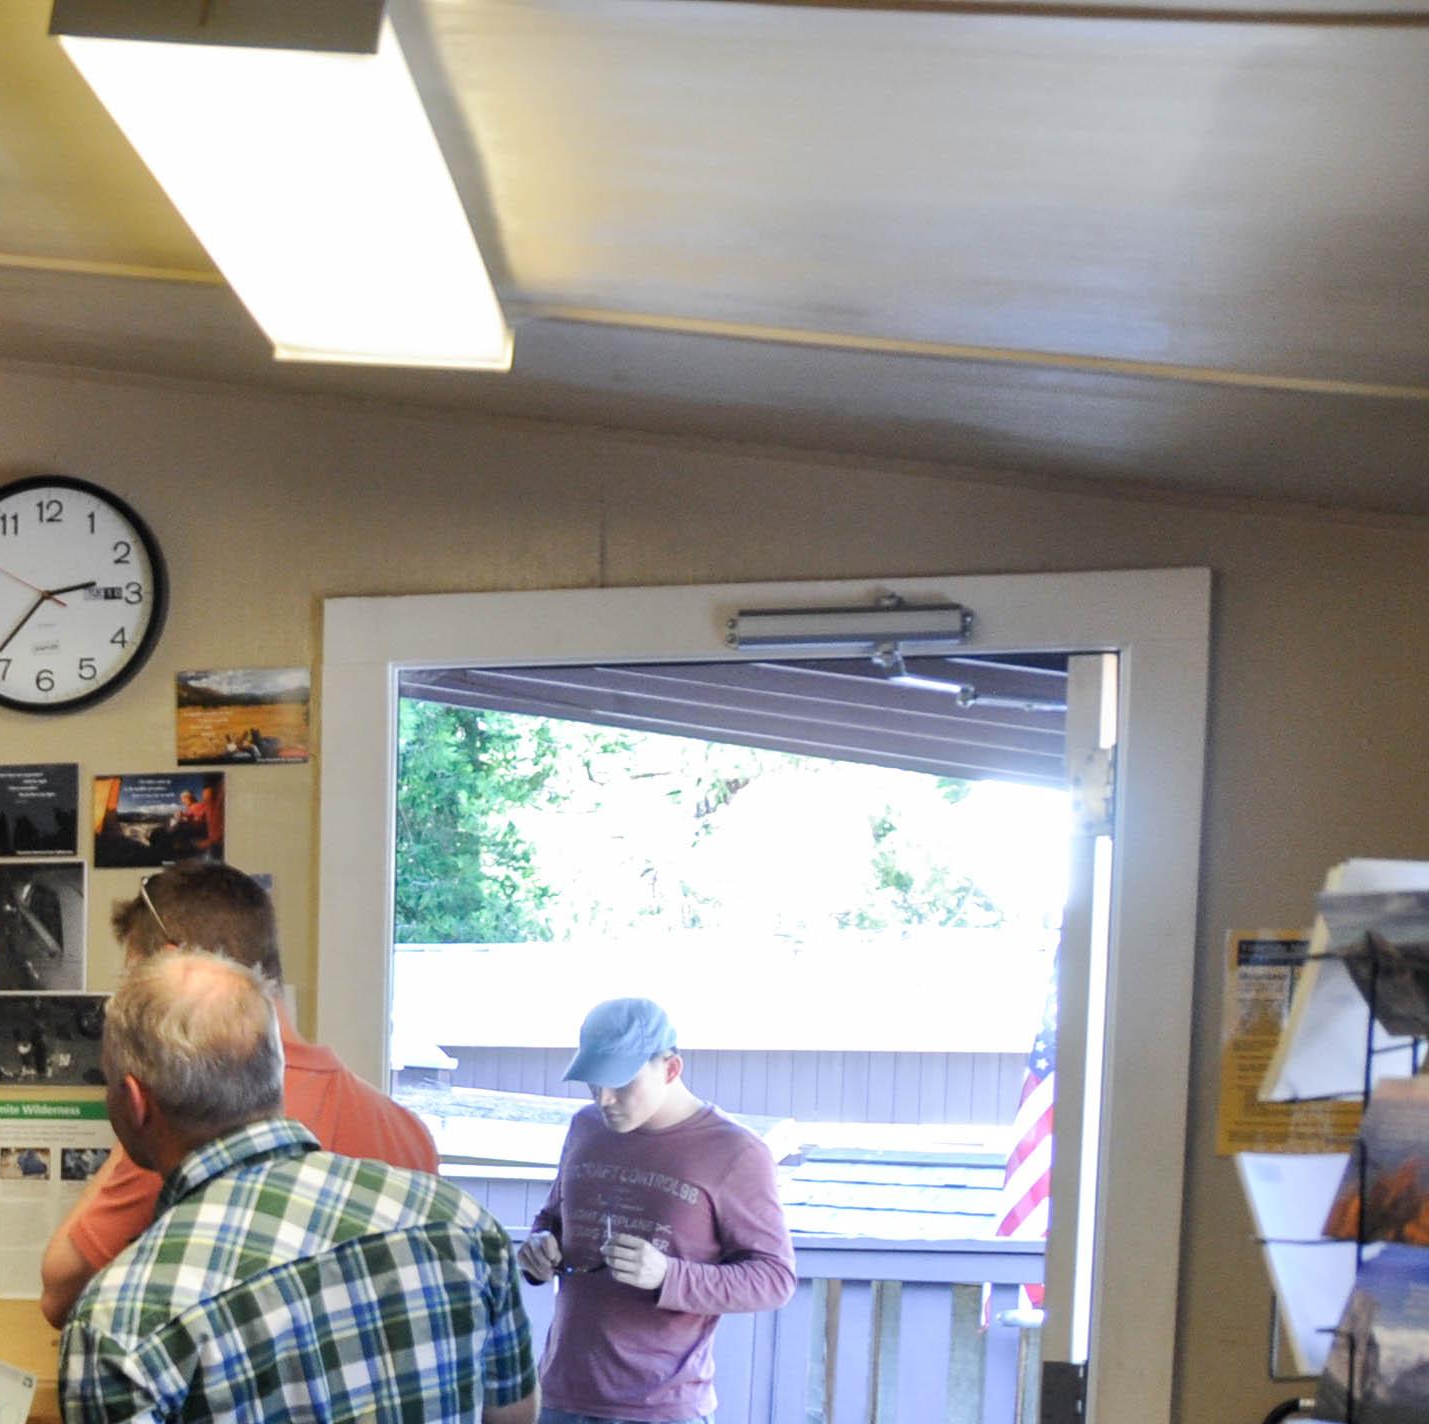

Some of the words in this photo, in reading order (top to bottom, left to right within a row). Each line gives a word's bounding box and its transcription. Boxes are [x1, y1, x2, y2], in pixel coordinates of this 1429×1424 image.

[36, 499, 63, 523] 12
[87, 511, 95, 534] 1
[0, 512, 19, 536] 11
[112, 541, 131, 564] 2
[124, 581, 143, 605] 3
[109, 626, 128, 649] 4
[78, 657, 97, 680] 5
[36, 669, 55, 692] 6
[22, 1104, 81, 1117] Wilderness
